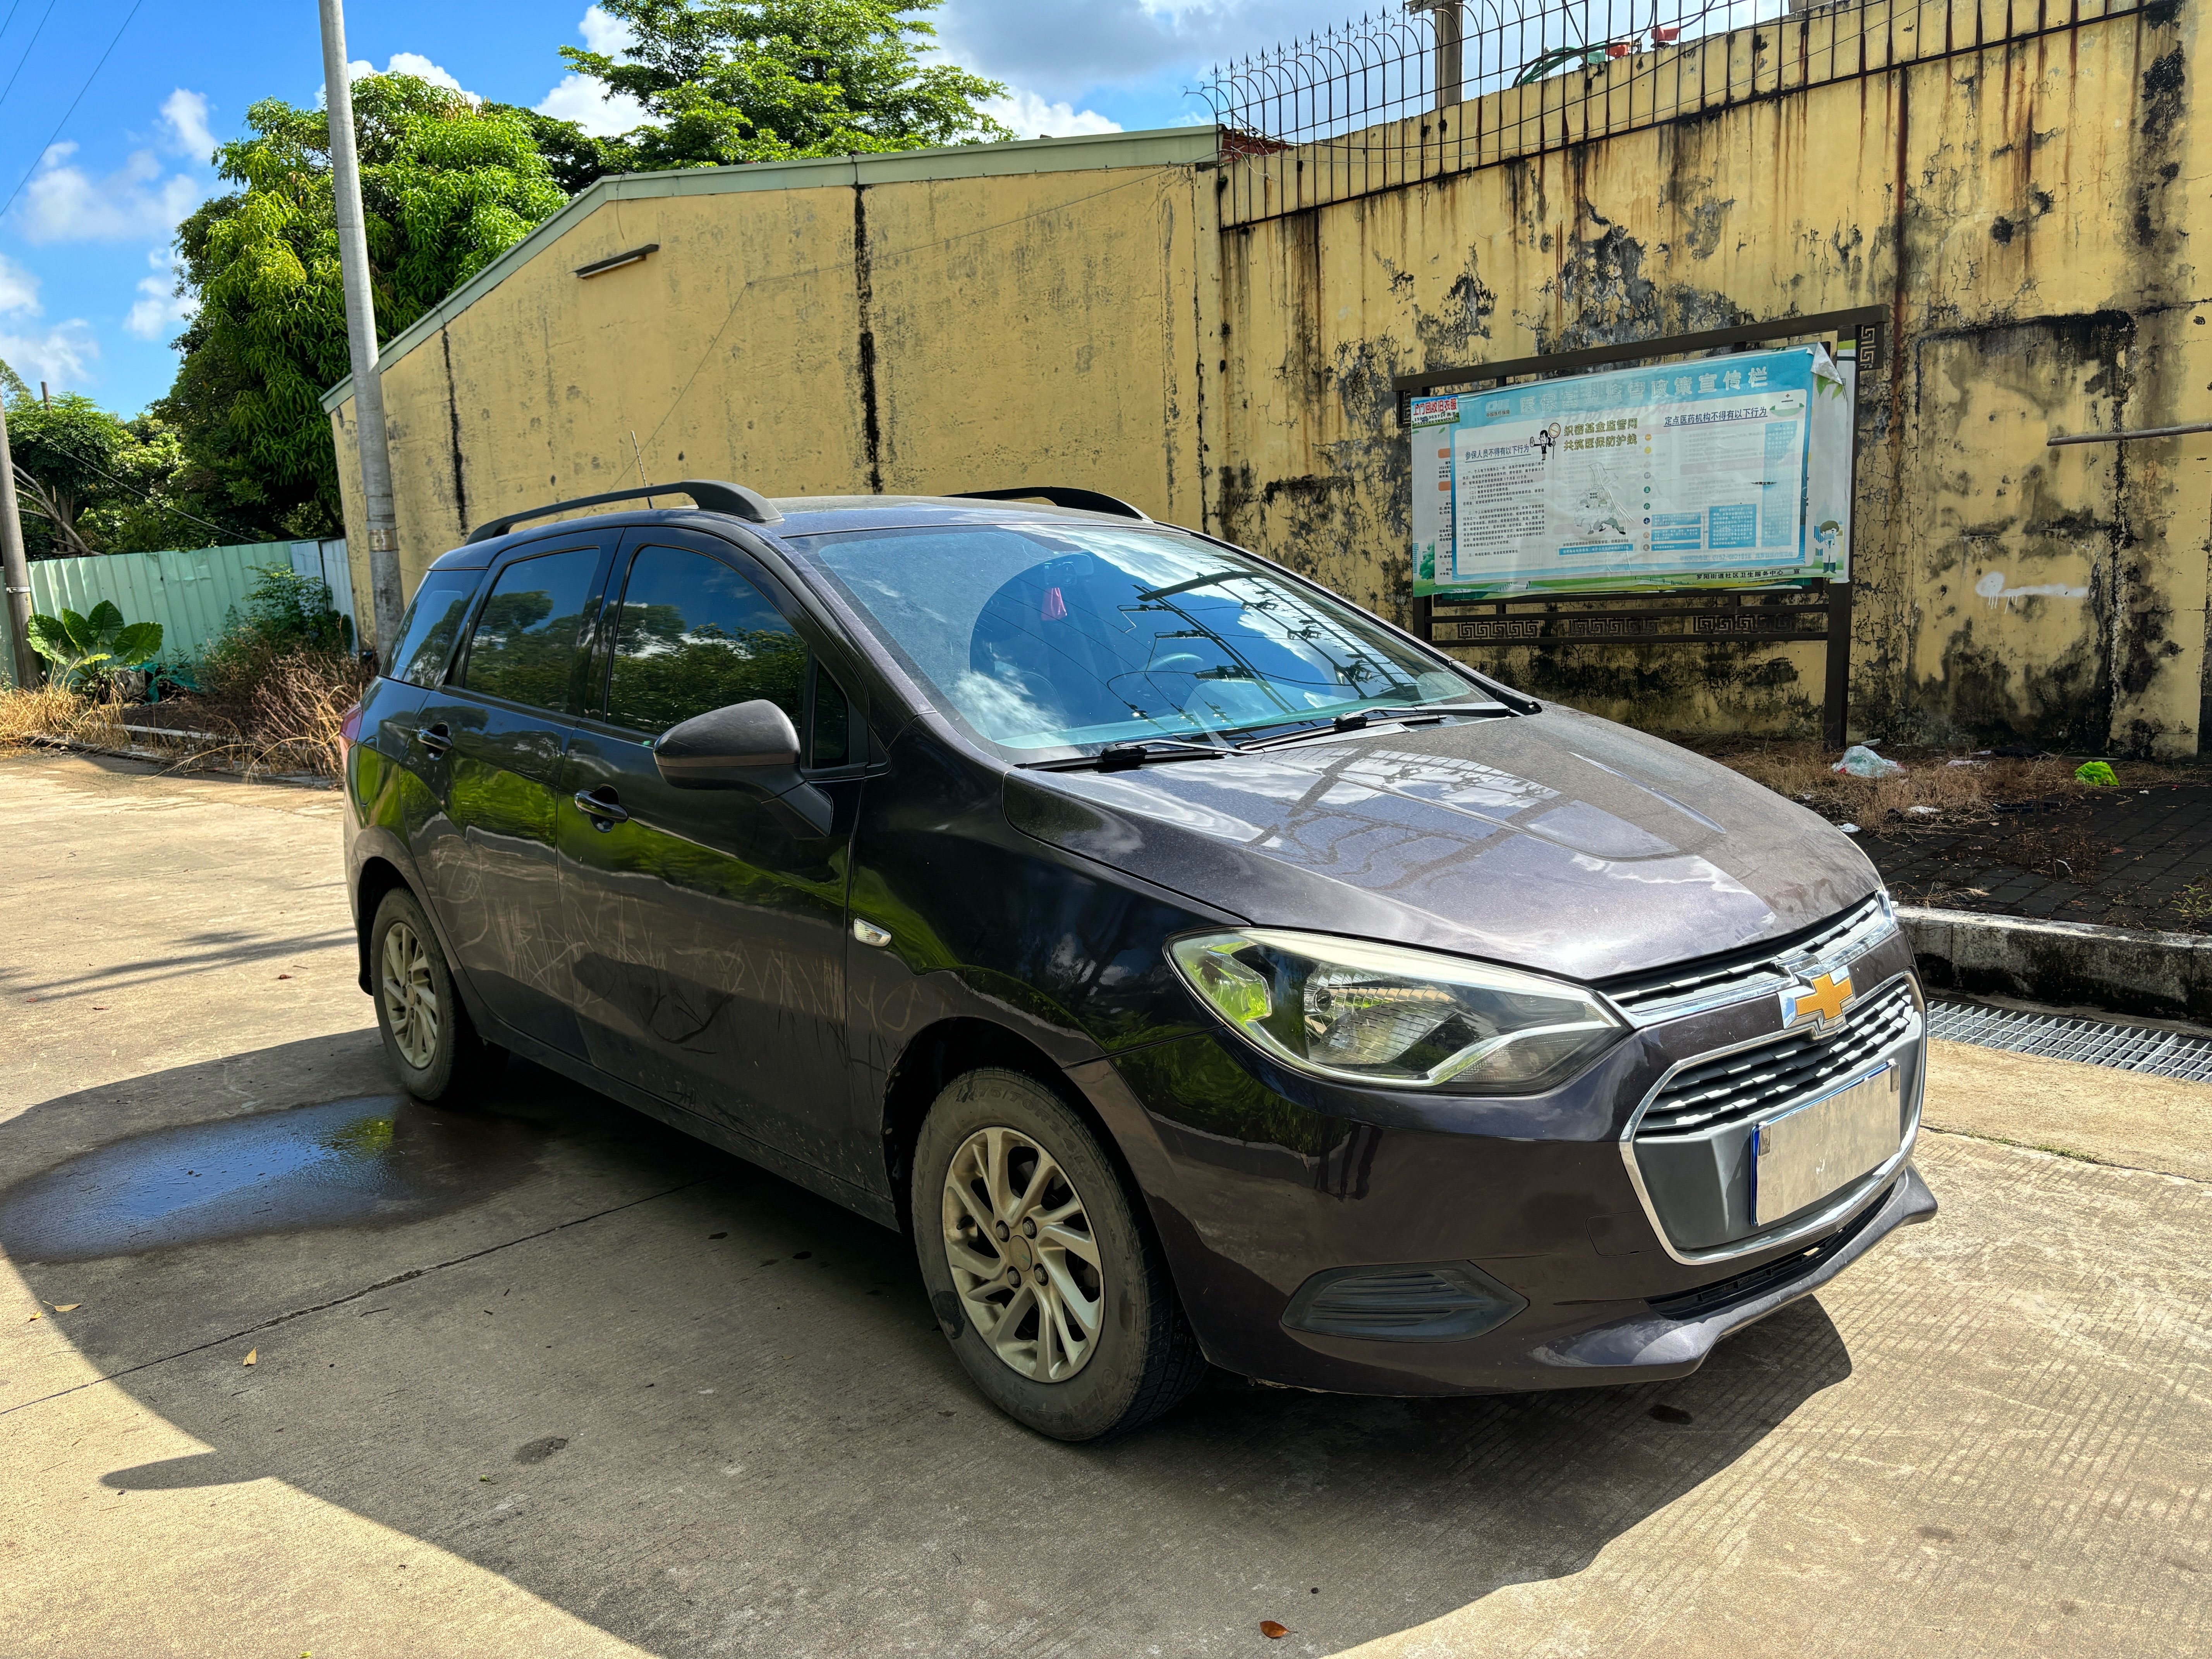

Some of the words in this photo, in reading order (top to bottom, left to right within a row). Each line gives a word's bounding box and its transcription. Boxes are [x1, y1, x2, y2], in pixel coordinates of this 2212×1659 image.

[1520, 366, 1768, 414] 医保基金监管政策宣传栏
[1413, 398, 1456, 416] 上门回收旧衣服
[1664, 407, 1767, 425] 定点医药机构不得有以下行为
[1564, 417, 1638, 436] 织密基金监管网
[1563, 433, 1637, 452] 共筑医保防护线
[1465, 444, 1529, 460] 参保人员不得有以下行为
[1697, 570, 1783, 580] 罗阳街道社区卫生服务中心
